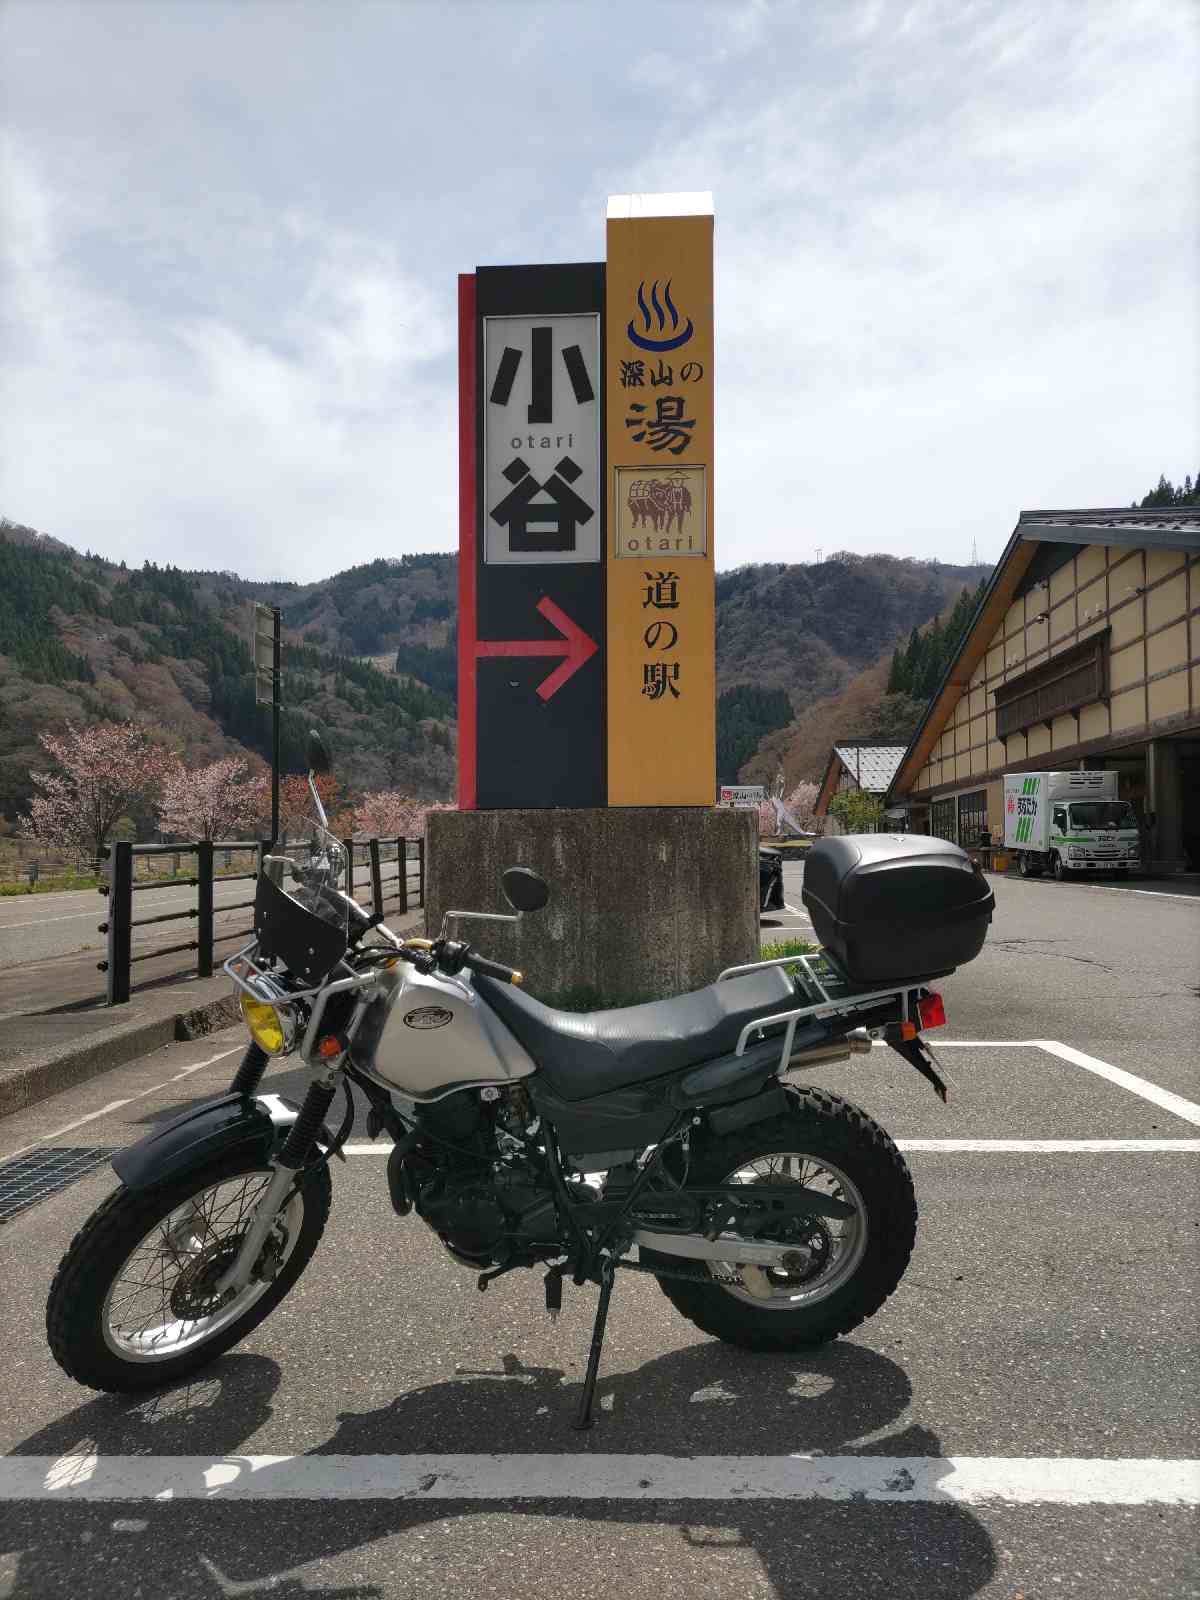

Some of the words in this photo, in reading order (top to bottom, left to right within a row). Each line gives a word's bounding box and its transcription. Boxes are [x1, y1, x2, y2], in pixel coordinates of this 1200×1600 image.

[620, 359, 704, 388] 深山の
[625, 396, 696, 455] 湯
[511, 433, 575, 450] otari
[628, 535, 694, 551] otari
[640, 571, 680, 700] 道の駅
